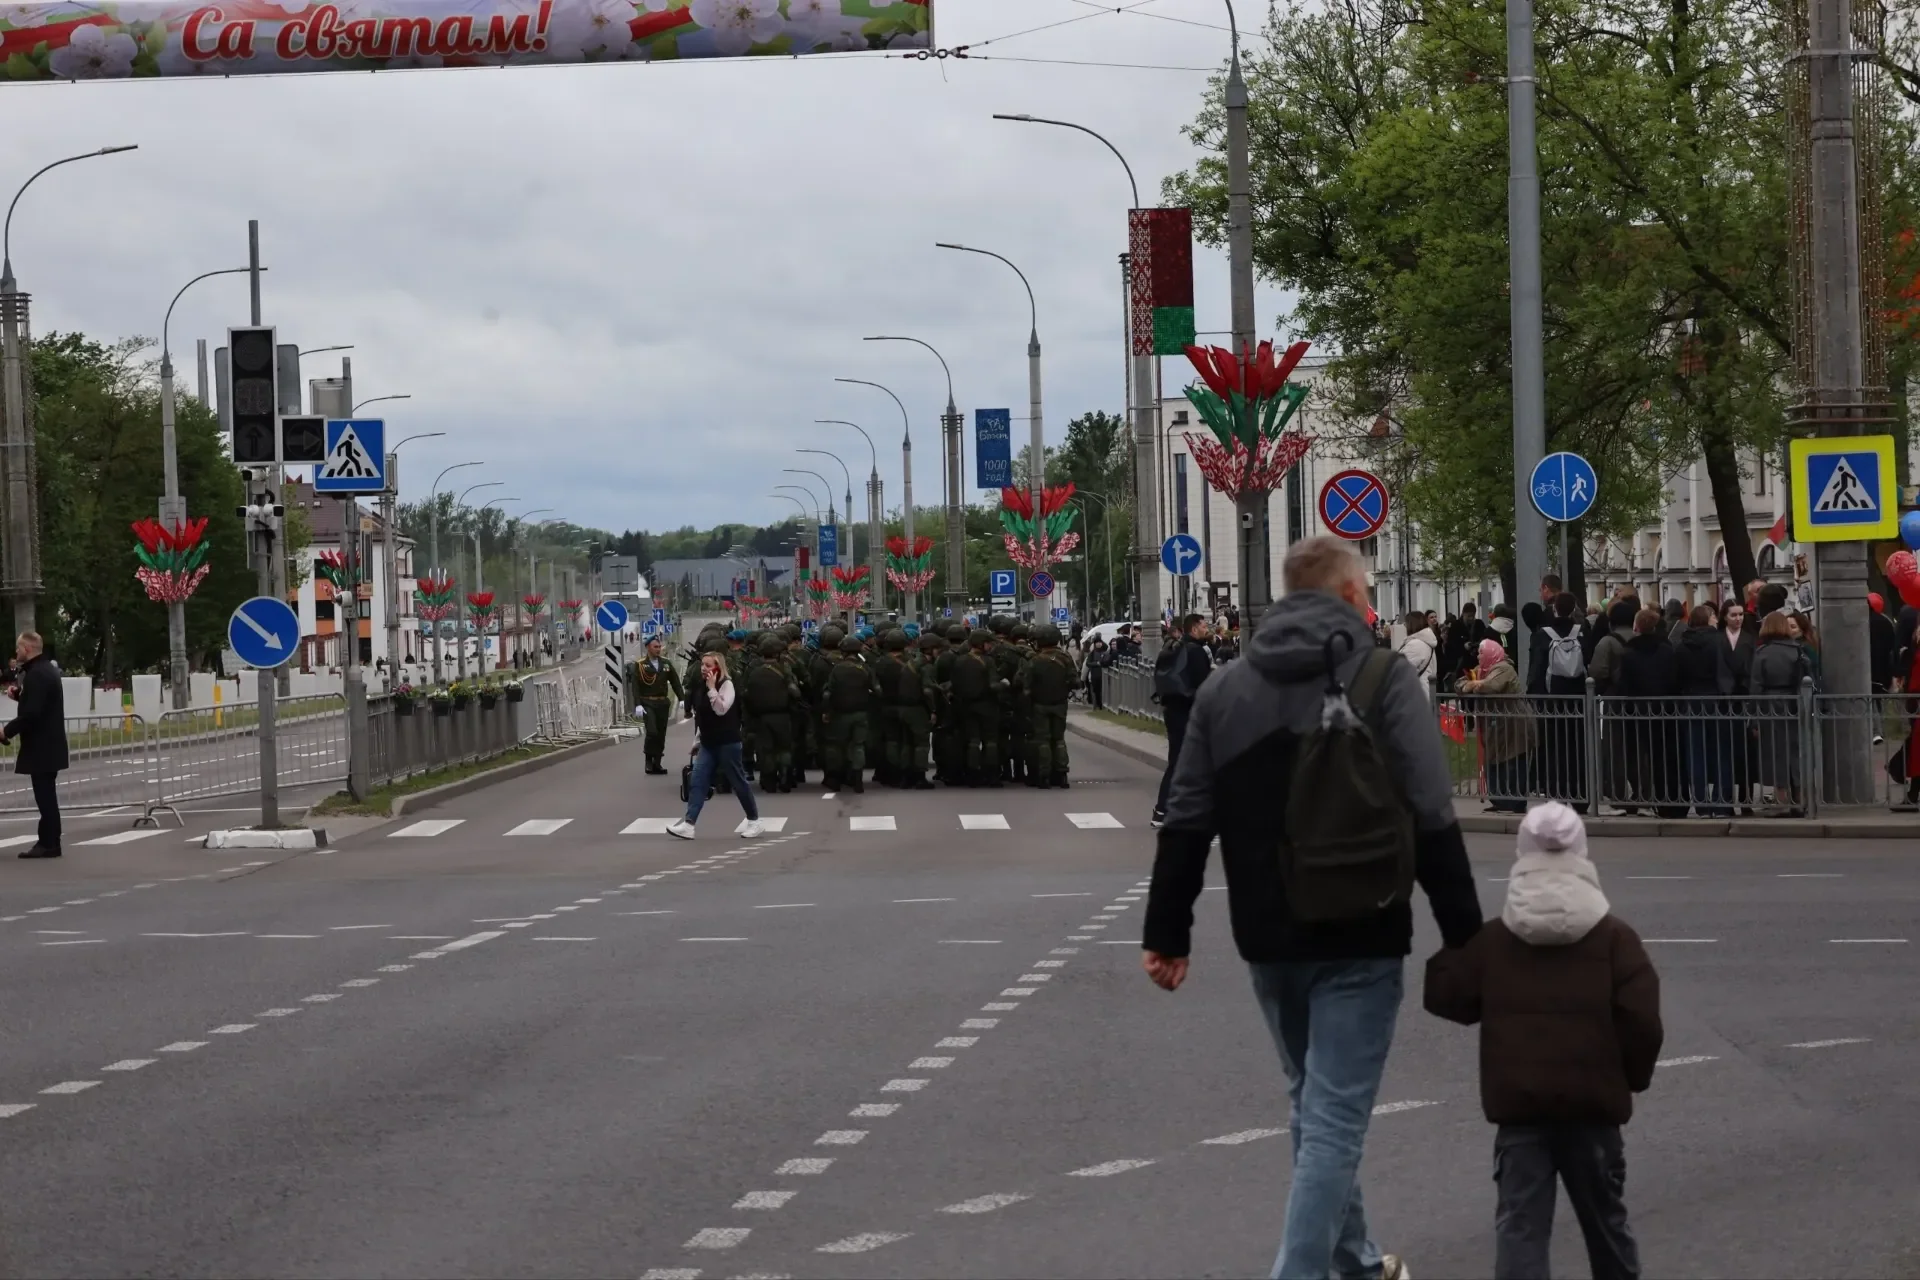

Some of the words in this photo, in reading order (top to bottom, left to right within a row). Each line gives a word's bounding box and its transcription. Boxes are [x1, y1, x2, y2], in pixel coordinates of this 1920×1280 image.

[181, 5, 255, 61] Са
[275, 0, 551, 60] святам!
[984, 459, 1007, 471] 1000
[996, 573, 1011, 593] P
[1058, 608, 1066, 619] P
